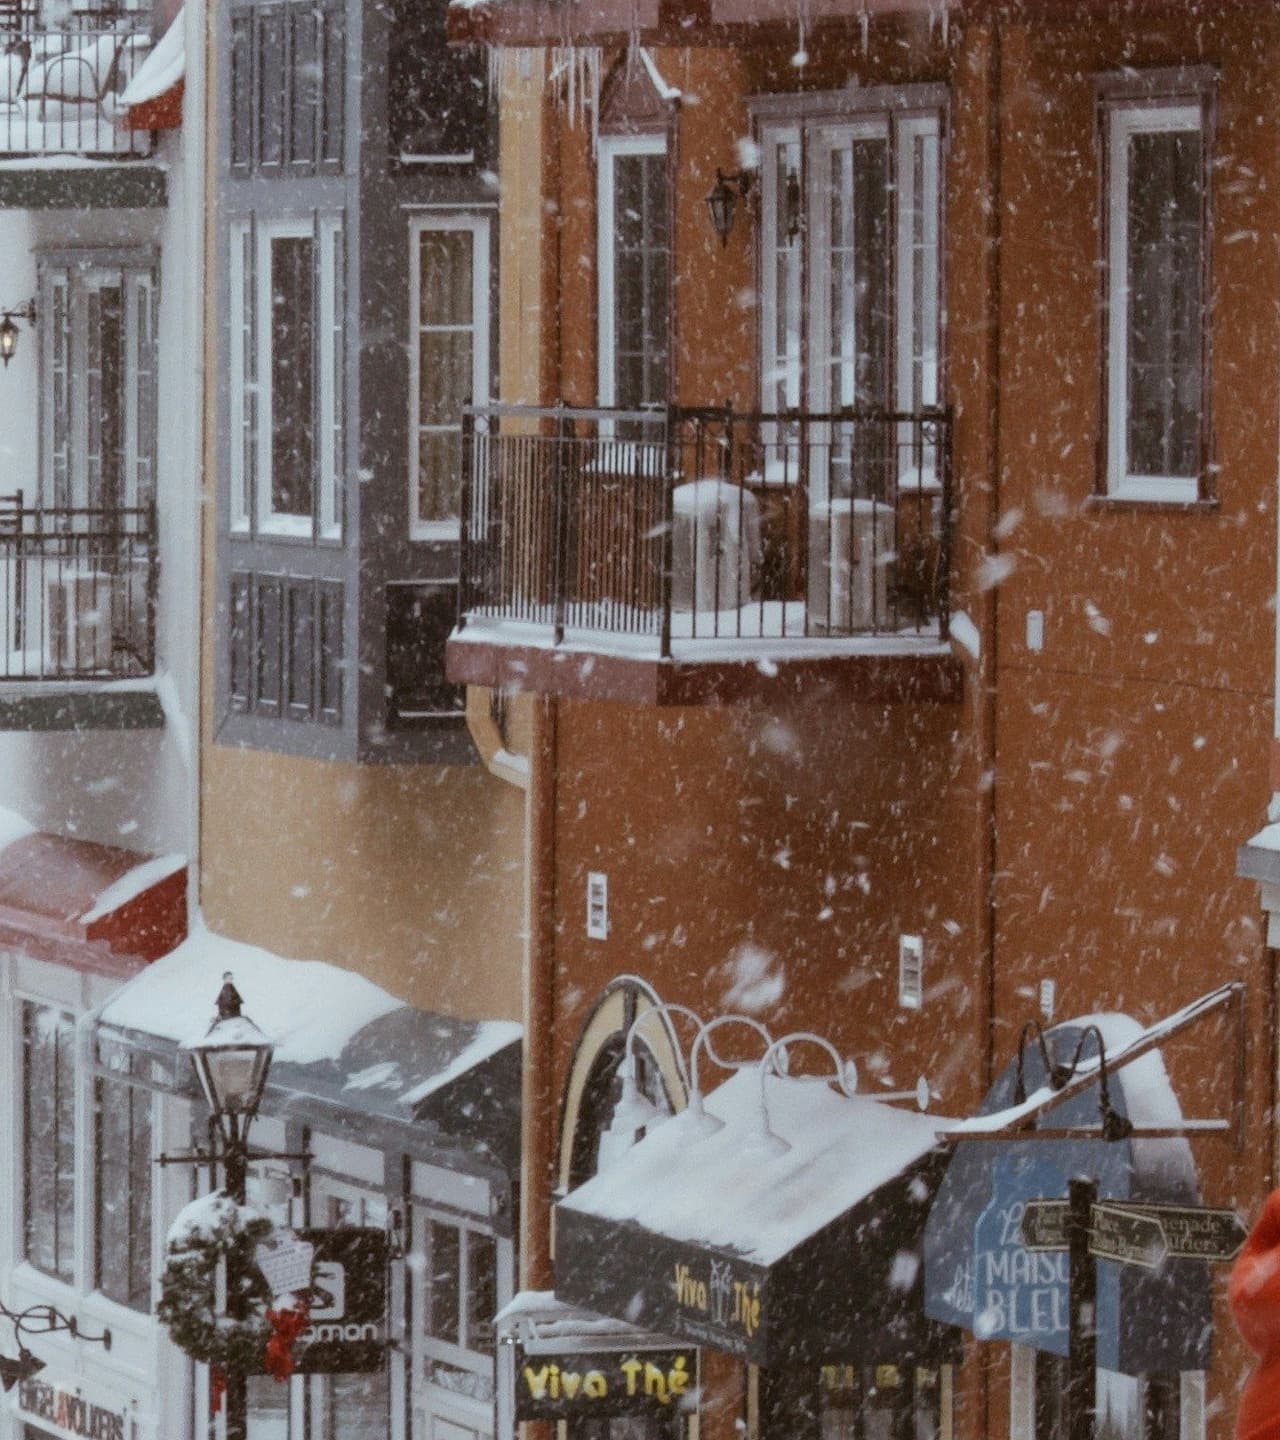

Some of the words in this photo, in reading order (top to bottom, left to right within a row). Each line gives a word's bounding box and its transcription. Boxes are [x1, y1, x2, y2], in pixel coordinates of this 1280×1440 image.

[675, 1263, 708, 1311] Viva
[733, 1280, 761, 1338] Thé
[524, 1363, 609, 1400] Viva
[620, 1355, 689, 1404] Thé
